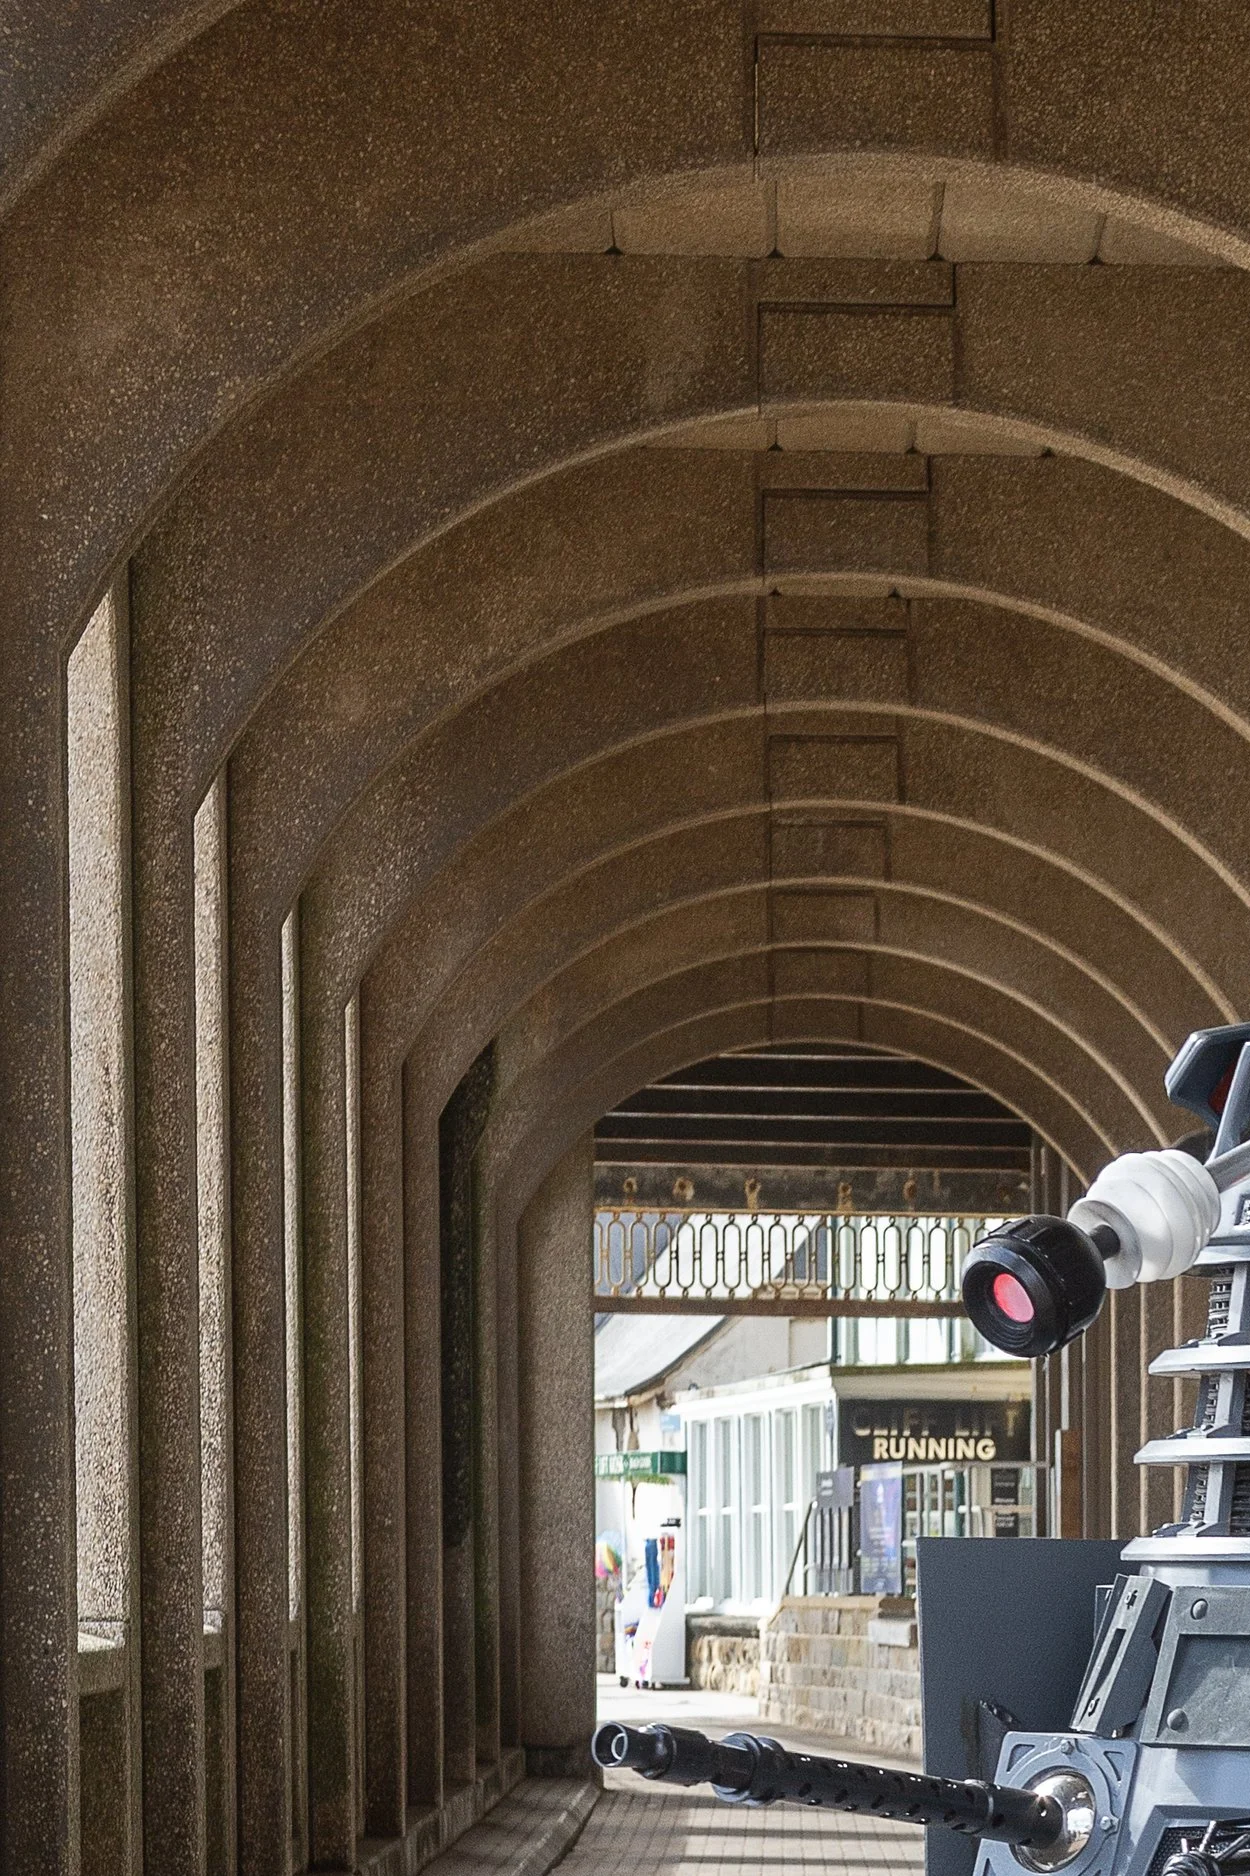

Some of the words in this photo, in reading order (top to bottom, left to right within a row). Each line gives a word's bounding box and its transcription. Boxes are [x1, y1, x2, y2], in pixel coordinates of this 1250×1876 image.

[850, 1407, 937, 1437] CLIFF
[954, 1408, 1021, 1437] LIFT
[872, 1437, 996, 1461] RUNNING
